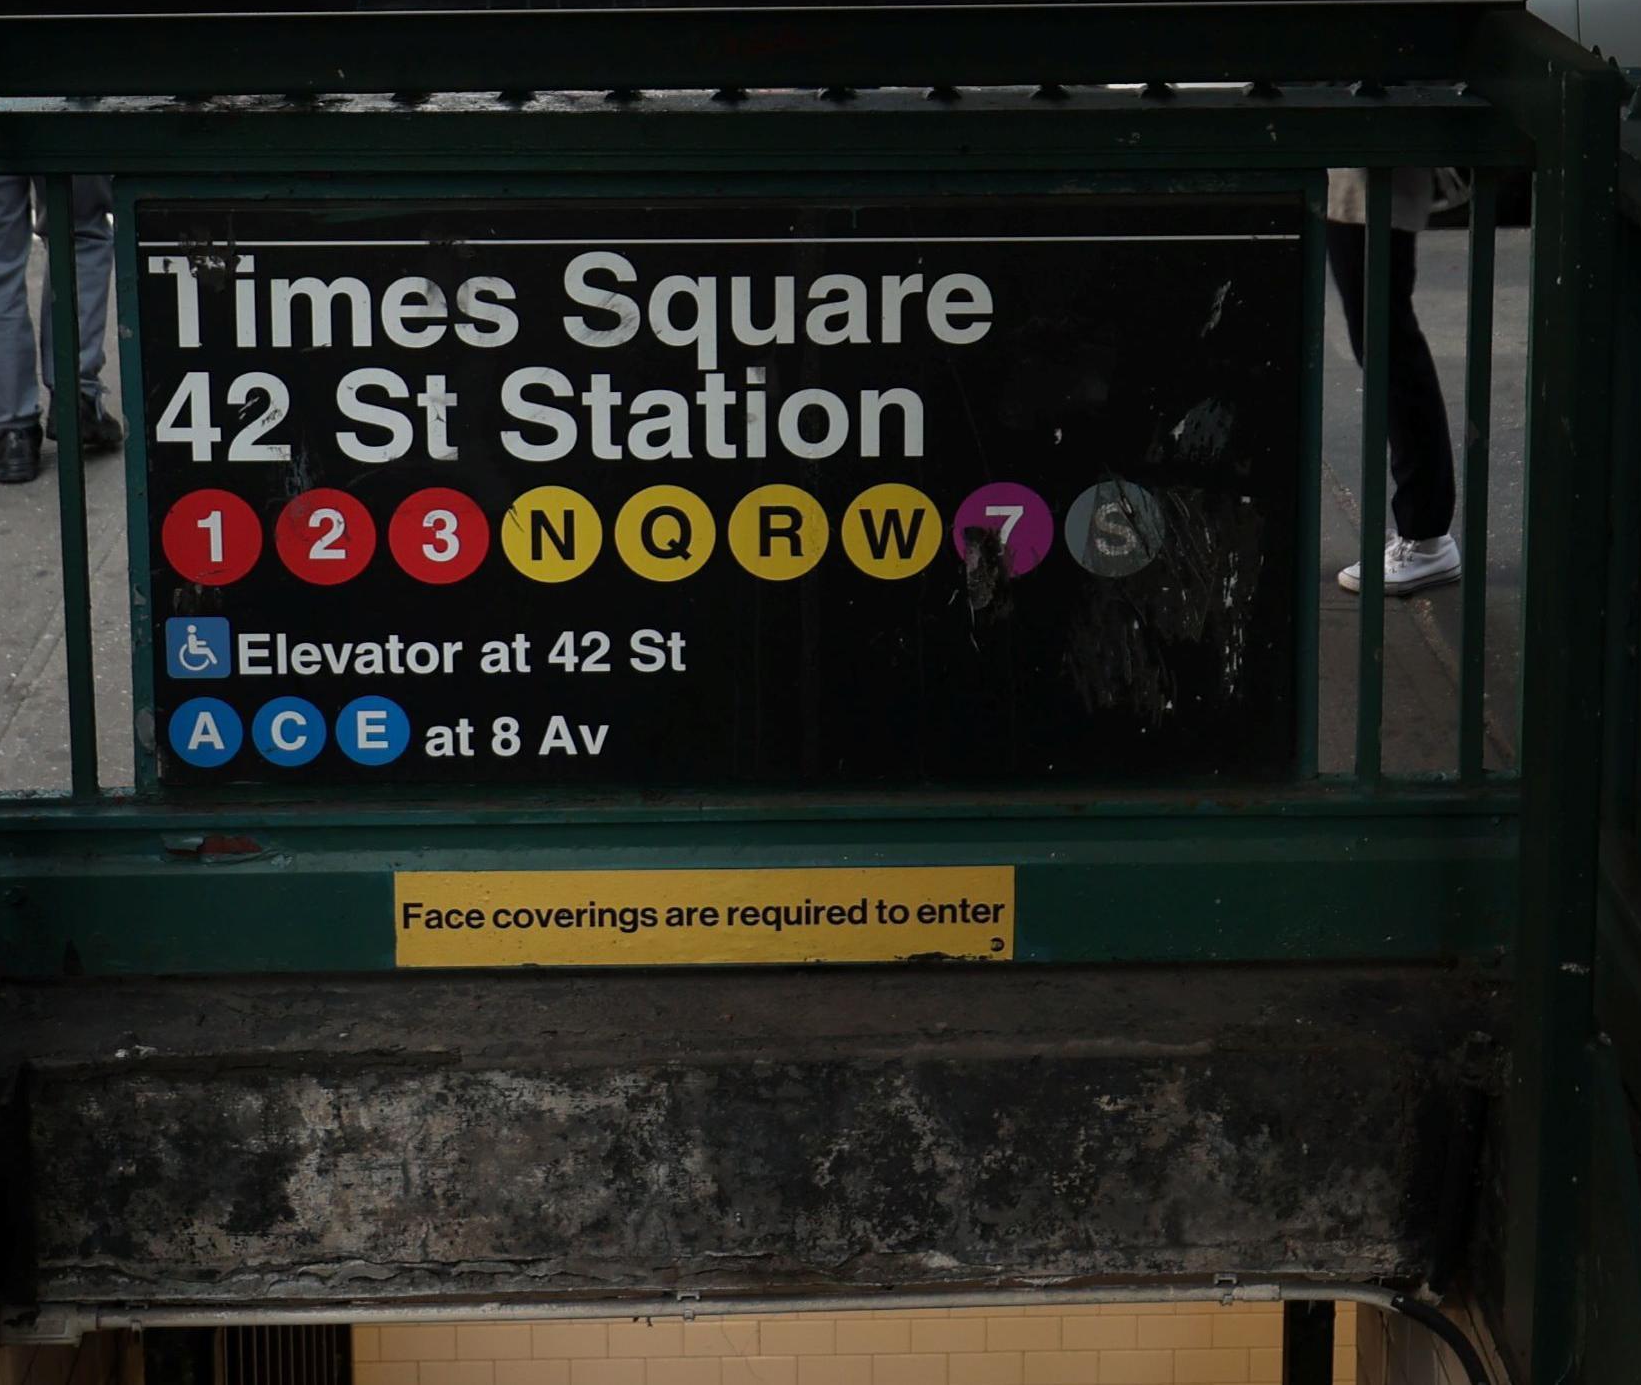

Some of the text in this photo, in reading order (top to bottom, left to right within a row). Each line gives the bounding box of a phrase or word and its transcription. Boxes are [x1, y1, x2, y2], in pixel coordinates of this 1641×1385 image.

[149, 251, 993, 370] Times Square
[156, 367, 924, 462] 42 St Station
[198, 502, 1137, 564] 1 2 3 N Q R W 7 S
[239, 629, 686, 674] Elevator at 42 St
[188, 711, 609, 756] A C E at 8 Av
[403, 898, 1005, 933] Face coverings are required to enter
